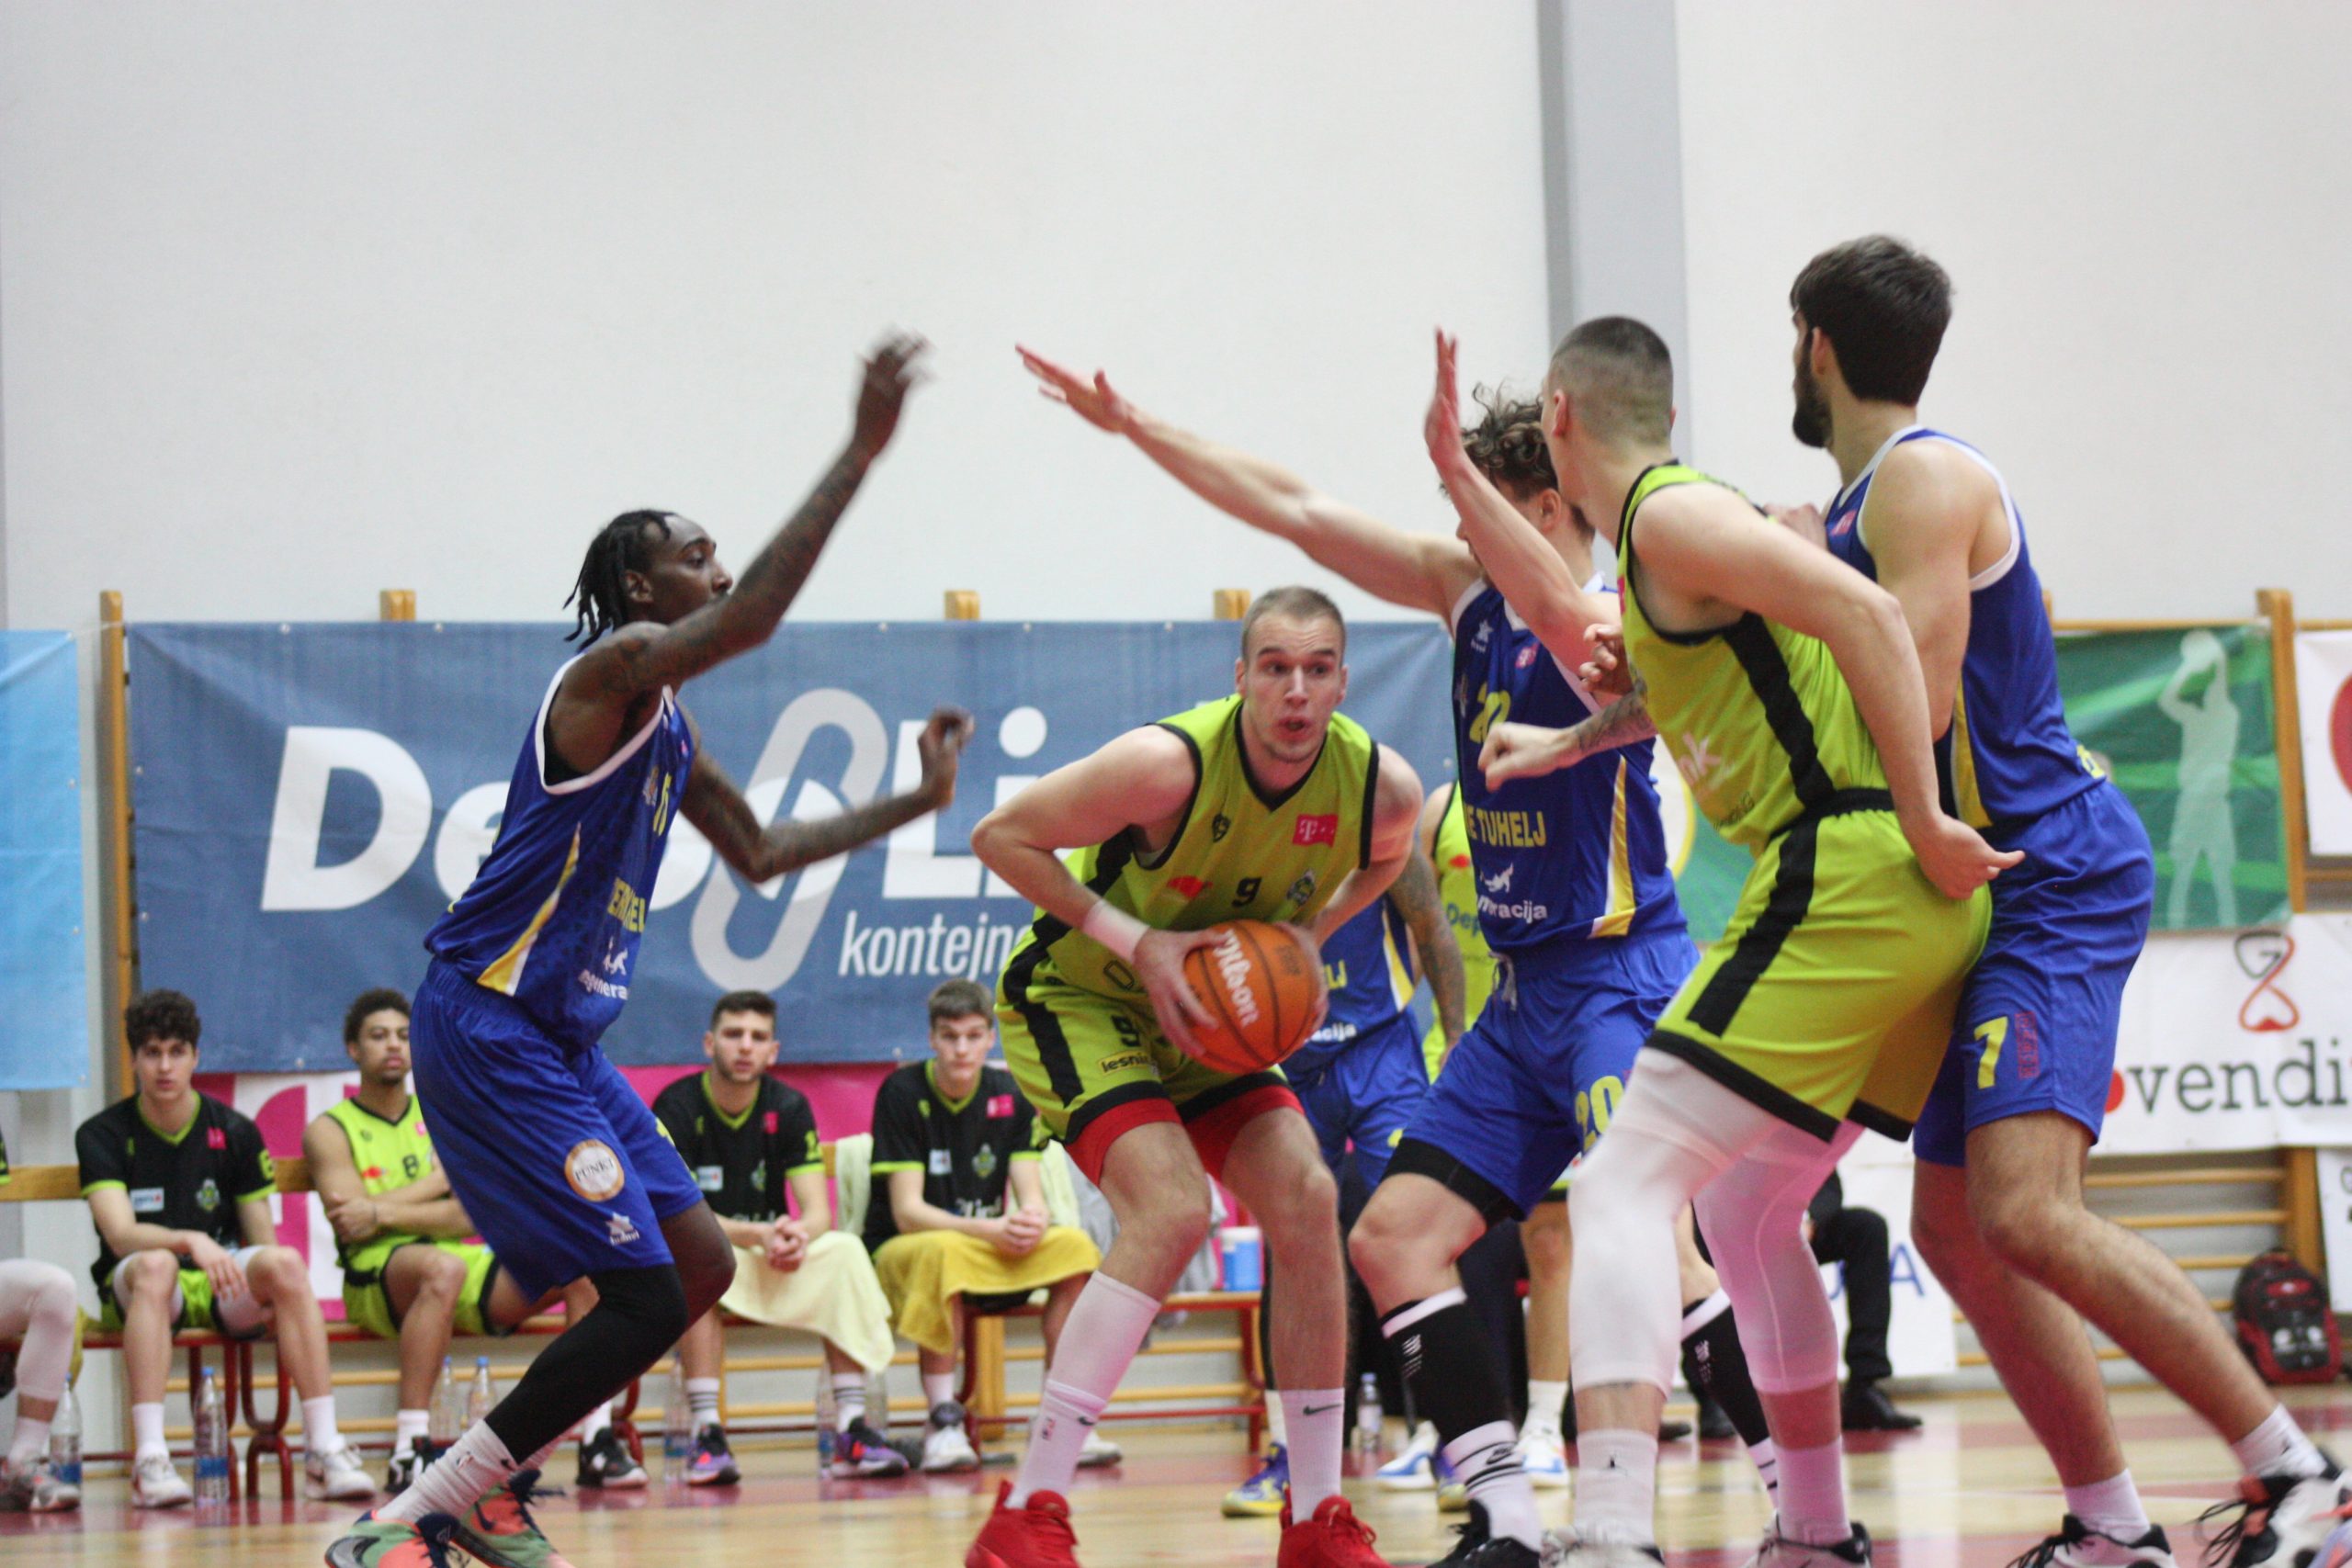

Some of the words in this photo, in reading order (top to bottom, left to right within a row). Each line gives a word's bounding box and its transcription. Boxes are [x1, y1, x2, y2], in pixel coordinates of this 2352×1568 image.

[1470, 682, 1511, 744] 20
[1476, 809, 1547, 848] TUHELJ
[1231, 876, 1263, 908] 9
[838, 909, 1031, 982] kontejn
[1111, 1015, 1141, 1047] 9
[1973, 1015, 2008, 1090] 7
